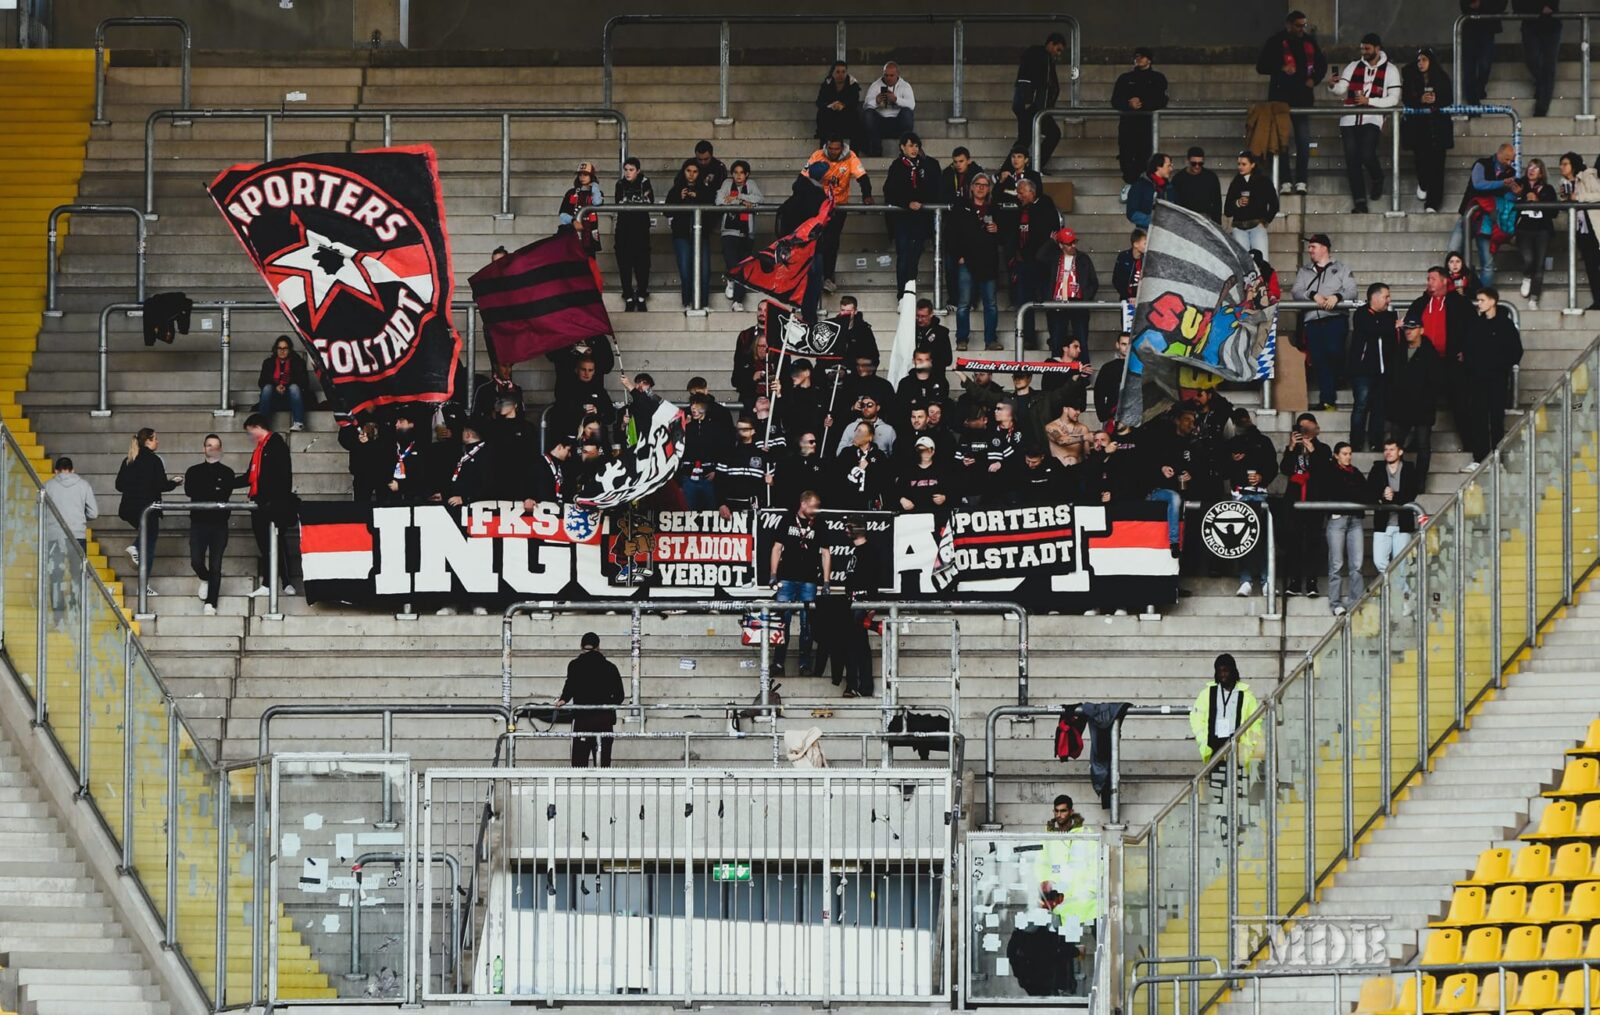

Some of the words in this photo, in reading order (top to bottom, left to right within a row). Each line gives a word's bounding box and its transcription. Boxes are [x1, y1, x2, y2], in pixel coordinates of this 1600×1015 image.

[965, 361, 996, 370] Black
[998, 363, 1019, 371] Red
[1021, 364, 1070, 373] Company
[470, 501, 561, 535] FKS
[658, 510, 748, 533] SEKTION
[951, 504, 1072, 534] PORTERS
[1205, 511, 1215, 523] IN
[1215, 503, 1256, 523] KOGNITO
[658, 534, 748, 561] STADION
[1205, 535, 1254, 556] INGOLSTADT
[658, 563, 746, 587] VERBOT
